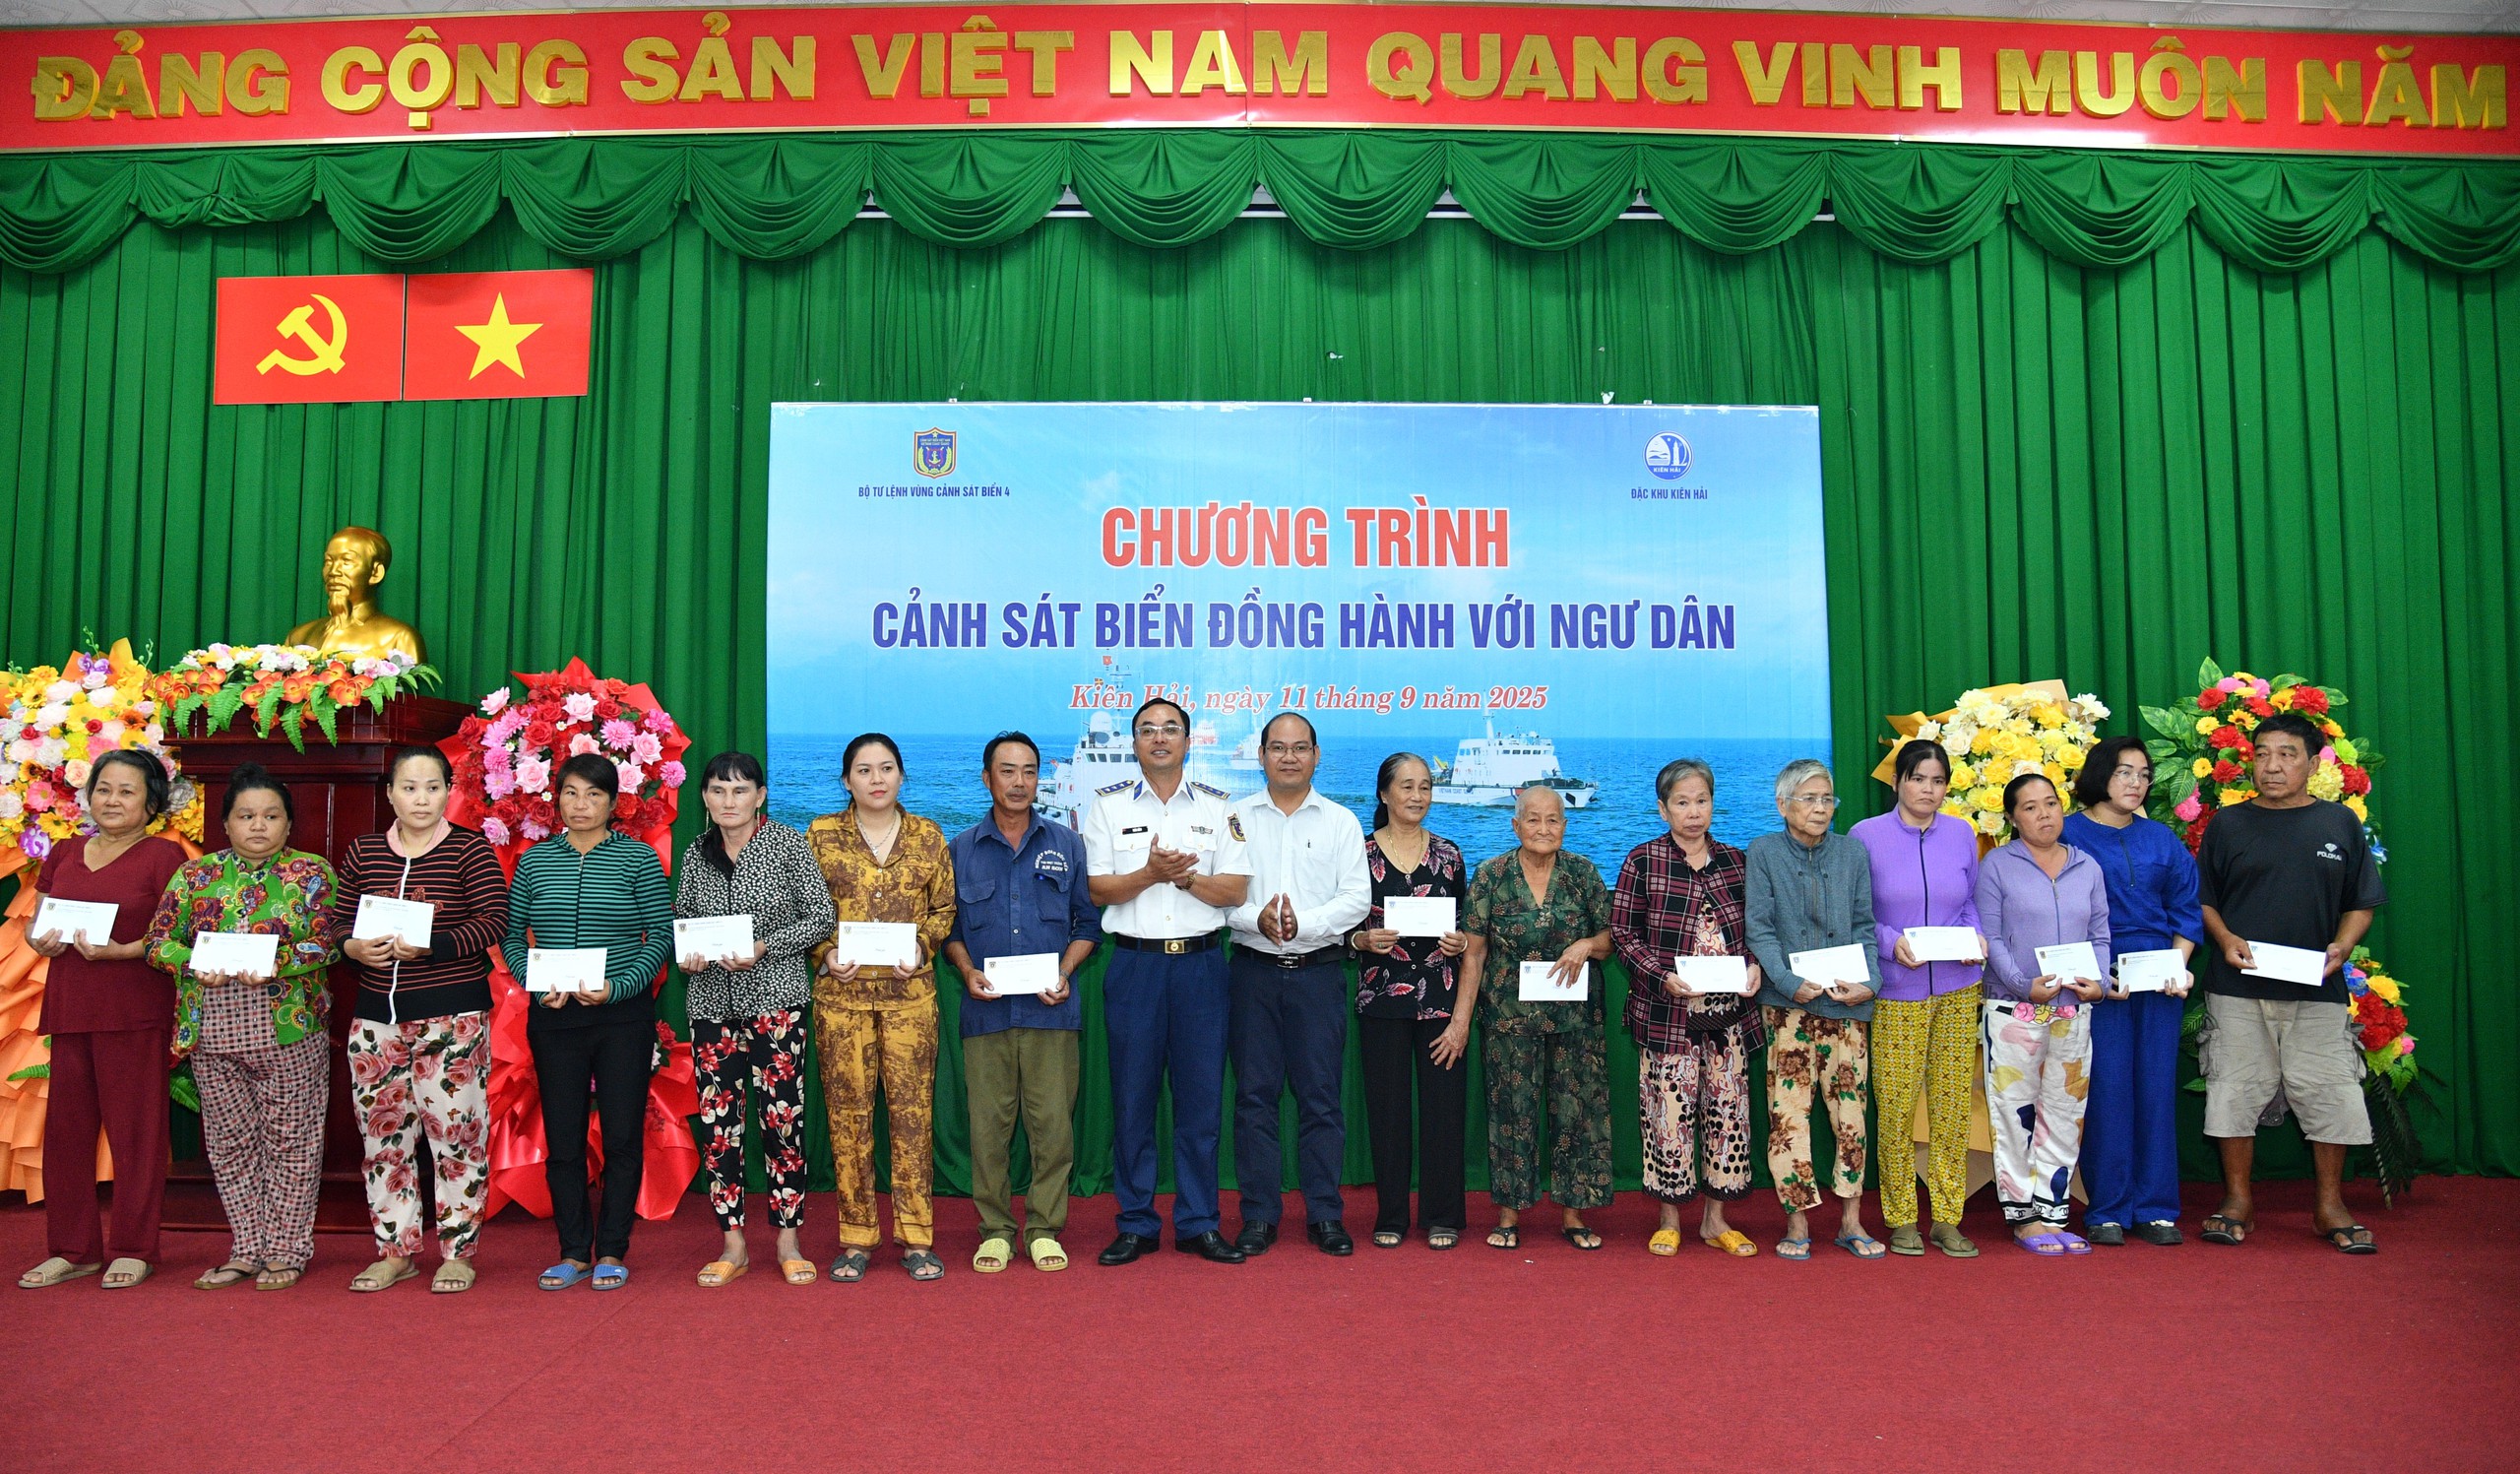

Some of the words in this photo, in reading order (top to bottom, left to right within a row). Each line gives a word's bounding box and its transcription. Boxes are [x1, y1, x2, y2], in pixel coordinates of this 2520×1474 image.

[32, 29, 290, 121] ĐẢNG
[320, 26, 589, 130] CỘNG
[620, 12, 816, 104] SẢN
[851, 15, 1075, 117] VIỆT
[1108, 30, 1329, 97] NAM
[1365, 32, 1708, 106] QUANG
[1732, 40, 1963, 111] VINH
[1996, 35, 2268, 122] MUÔN
[2297, 44, 2506, 129] NĂM
[858, 484, 870, 499] BỘ
[873, 485, 884, 497] TƯ
[886, 484, 908, 499] LỆNH
[911, 483, 934, 497] VÙNG
[936, 483, 960, 497] CẢNH
[963, 483, 978, 497] SÁT
[981, 481, 1002, 497] BIỂN
[1004, 486, 1010, 497] 4
[1631, 486, 1649, 501] ĐẶC
[1651, 488, 1669, 499] KHU
[1670, 486, 1690, 499] KIÊN
[1693, 485, 1708, 499] HẢI
[1101, 501, 1329, 568] CHƯƠNG
[1345, 494, 1510, 568] TRÌNH
[872, 586, 987, 650] CẢNH
[1001, 592, 1082, 650] SÁT
[1095, 583, 1194, 650] BIỂN
[1207, 587, 1324, 650] ĐỒNG
[1339, 593, 1455, 650] HÀNH
[1468, 593, 1536, 650] VỚI
[1550, 599, 1641, 650] NGƯ
[1651, 594, 1735, 650] DÂN
[1070, 685, 1133, 708] Kiên
[1204, 686, 1272, 713] ngày
[1280, 686, 1307, 708] 11
[1315, 686, 1394, 713] tháng
[1400, 686, 1417, 709] 9
[1422, 686, 1480, 709] năm
[1487, 686, 1548, 709] 2025
